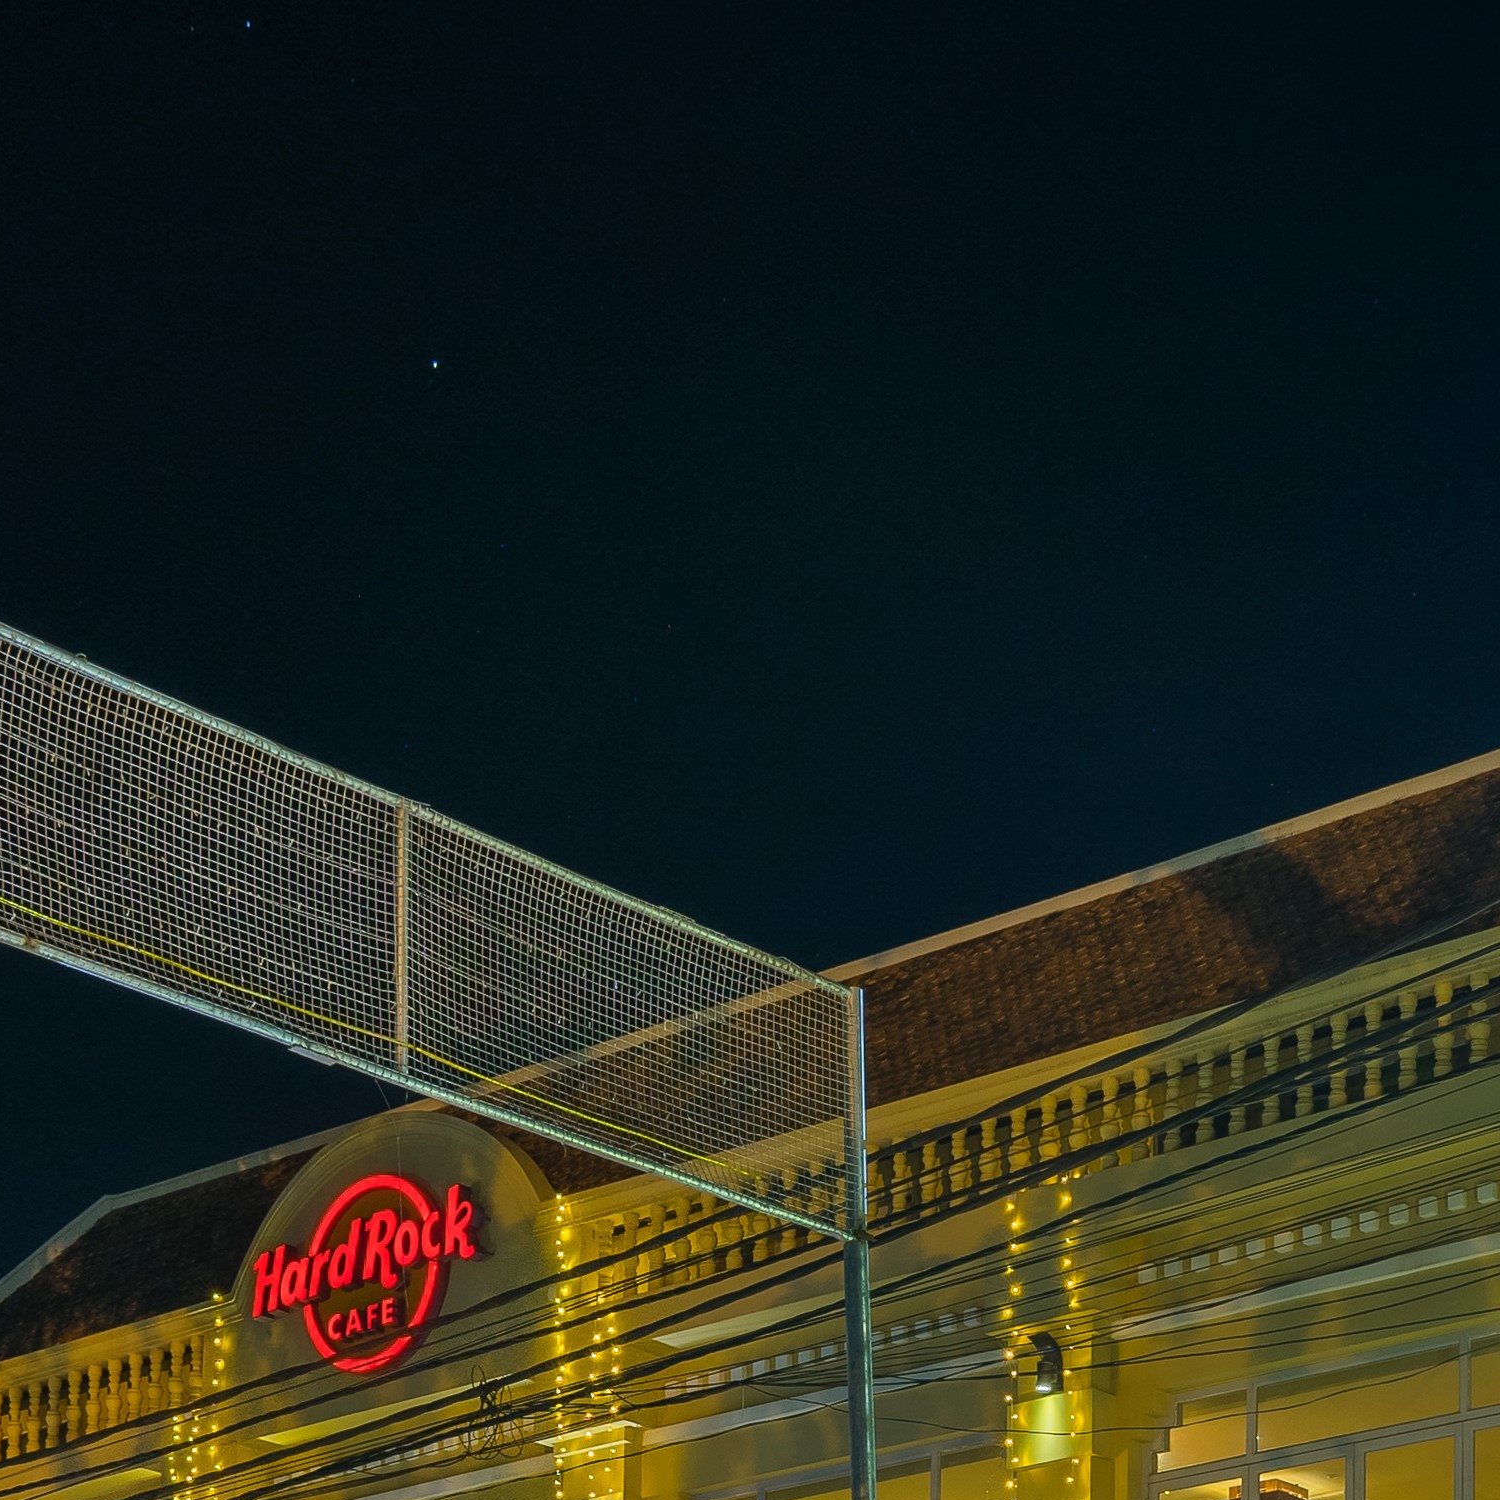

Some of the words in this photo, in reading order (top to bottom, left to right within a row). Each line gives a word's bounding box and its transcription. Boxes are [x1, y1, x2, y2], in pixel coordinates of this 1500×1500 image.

[252, 1217, 362, 1319] Hard
[362, 1183, 475, 1289] Rock
[327, 1297, 395, 1341] CAFE
